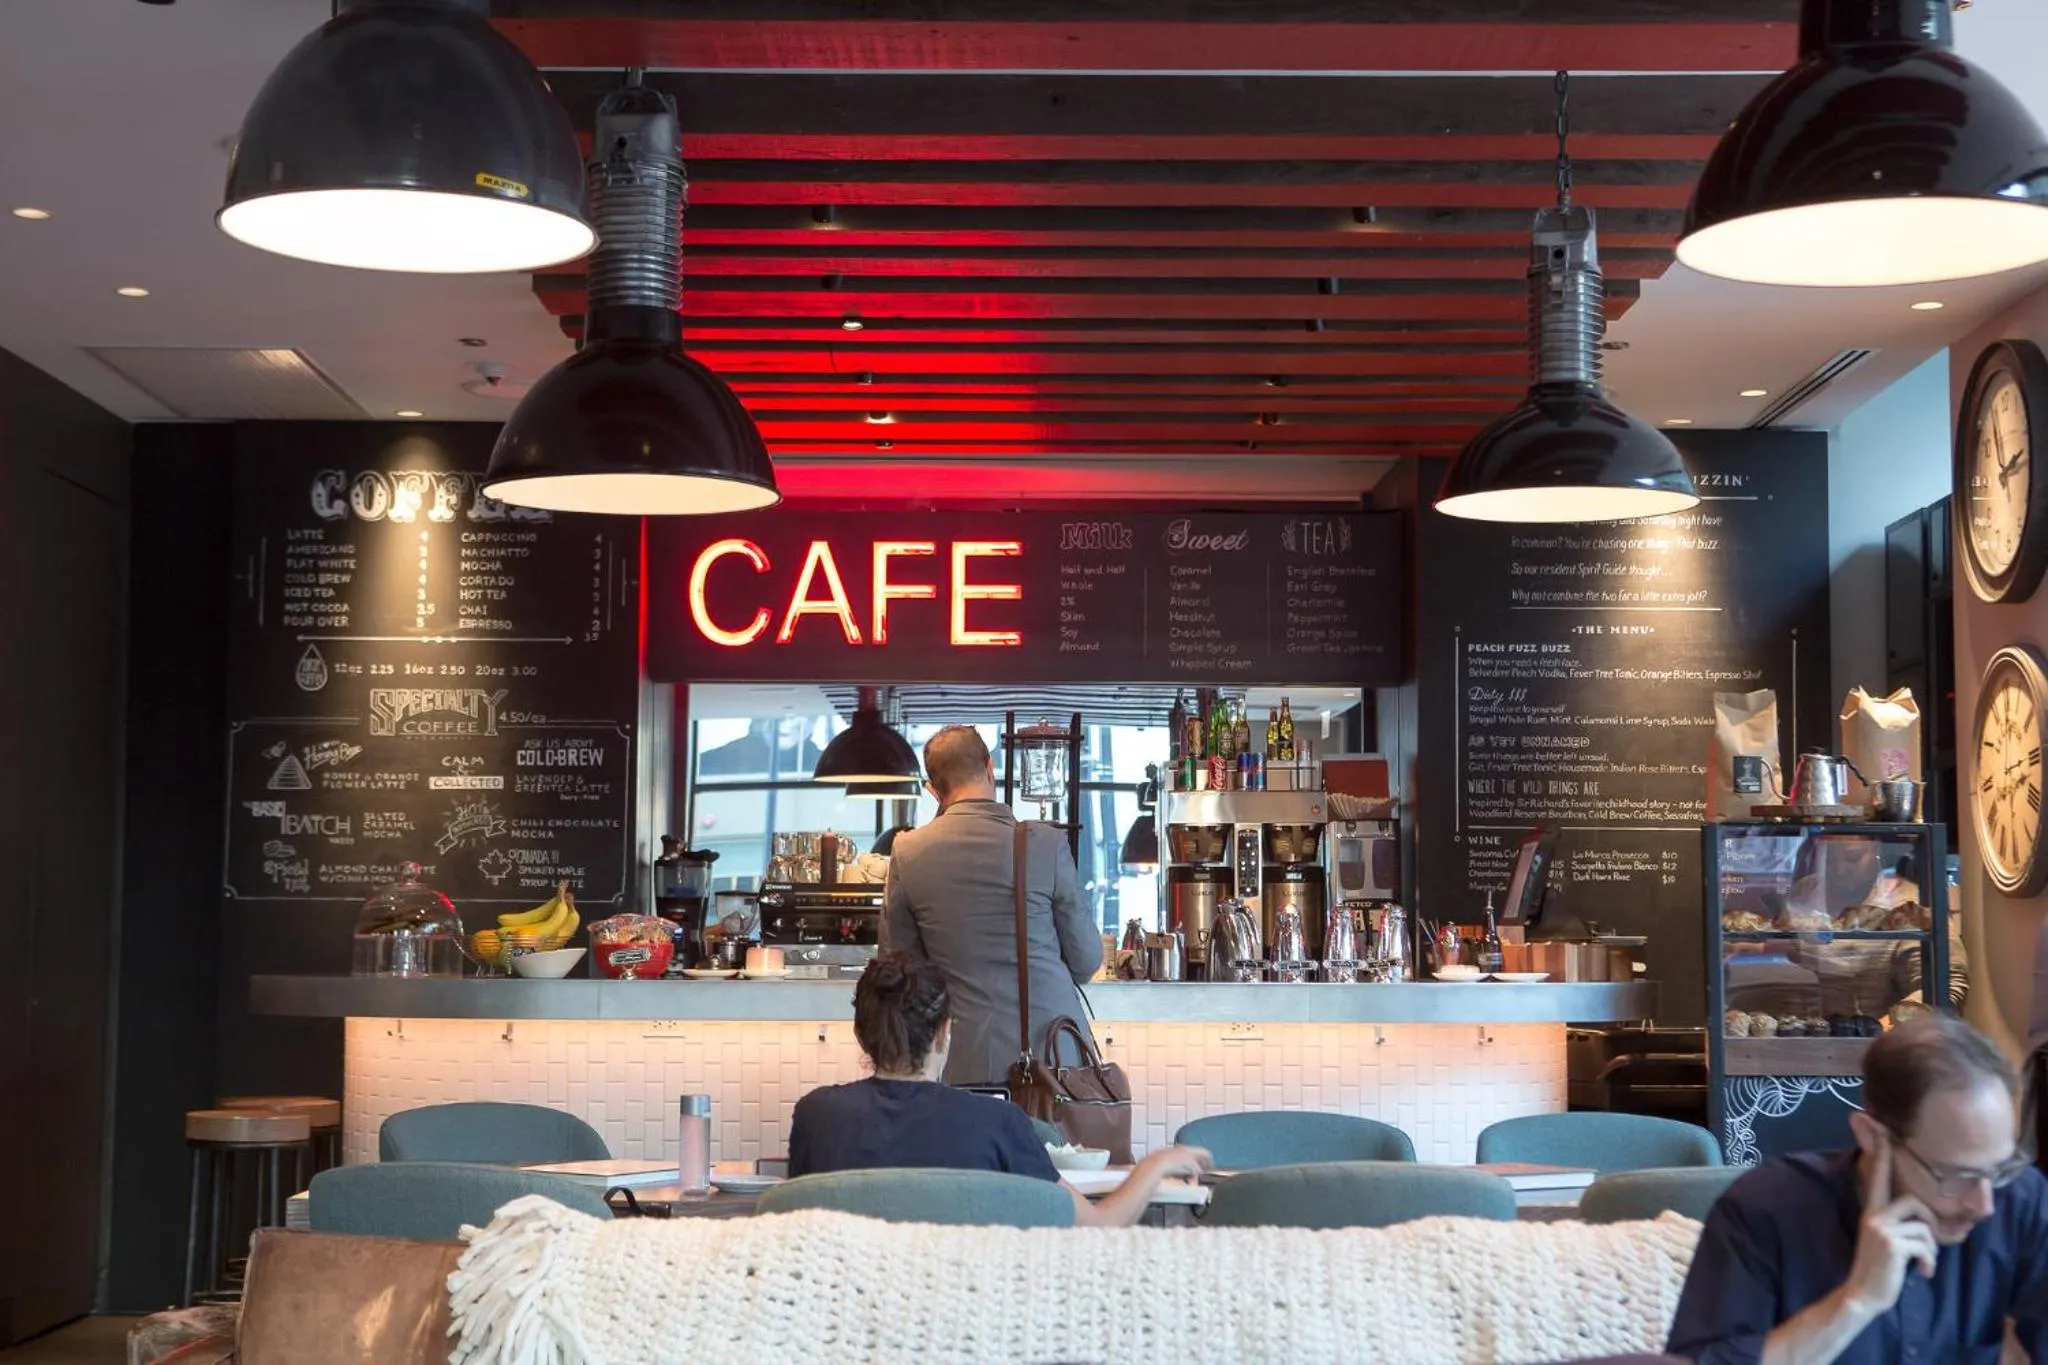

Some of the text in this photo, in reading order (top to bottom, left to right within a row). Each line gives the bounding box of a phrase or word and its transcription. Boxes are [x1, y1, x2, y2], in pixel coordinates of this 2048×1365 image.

[1693, 474, 1750, 487] ZZIN'
[311, 470, 553, 523] COFFE
[288, 529, 325, 540] LATTE
[461, 532, 537, 543] CAPPUCCINO
[1060, 520, 1133, 551] Milk
[1166, 519, 1250, 552] Sweet
[1300, 522, 1336, 555] TEA
[1593, 536, 1627, 553] chasing
[286, 558, 356, 569] FLAT WHITE
[461, 561, 503, 572] MOCHA
[1061, 565, 1082, 576] Half
[1107, 565, 1126, 576] Half
[1170, 565, 1212, 576] Caramel
[1539, 563, 1576, 577] resident
[459, 575, 515, 587] CORTADO
[1060, 580, 1094, 591] Whole
[314, 587, 336, 598] TEA
[459, 589, 507, 600] HOT TEA
[689, 538, 1022, 647] CAFE
[1511, 589, 1530, 603] Why
[1546, 589, 1583, 603] combine
[1601, 589, 1617, 603] two
[1661, 589, 1685, 603] extra
[459, 604, 489, 616] CHAI
[317, 616, 350, 627] OVER
[1060, 611, 1086, 622] Skim
[459, 619, 513, 630] ESPRESSO
[1576, 625, 1648, 634] THE MENU
[1060, 626, 1079, 640] Soy
[1169, 626, 1221, 638] Chocolate
[1060, 641, 1101, 652] Almond
[1468, 643, 1572, 653] PEACH FUZZ BUZZ
[1569, 668, 1594, 680] Fever
[1640, 669, 1673, 682] Orange
[1705, 669, 1741, 682] Espresso
[370, 688, 508, 736] SPECIALTY
[402, 720, 479, 733] COFFEE
[1521, 735, 1591, 748] UNNAMED
[441, 756, 485, 766] CALM
[375, 773, 420, 782] ORANGE
[433, 777, 502, 788] COLLECTED
[516, 774, 574, 784] LAVENDER
[370, 781, 406, 790] LATTE
[575, 783, 611, 793] LATTE
[1468, 780, 1496, 795] WHERE
[1549, 780, 1579, 795] THINGS
[1583, 780, 1600, 795] ARE
[1604, 798, 1648, 810] childhood
[1649, 798, 1669, 810] story
[1679, 798, 1693, 810] not
[1589, 809, 1608, 820] Cold
[1609, 809, 1634, 820] Brew
[1634, 809, 1664, 820] Coffee,
[363, 821, 416, 831] CARAMEL
[511, 818, 621, 828] CHILI CHOCOLATE
[362, 830, 403, 839] MOCHA
[511, 830, 554, 839] MOCHA
[1468, 836, 1501, 845] WINE
[1612, 851, 1650, 860] Prosecco
[1661, 851, 1678, 860] $10
[319, 864, 367, 874] ALMOND
[557, 866, 586, 875] MAPLE
[1661, 862, 1678, 873] $12
[1573, 872, 1590, 882] Dark
[519, 878, 549, 888] SYRUP
